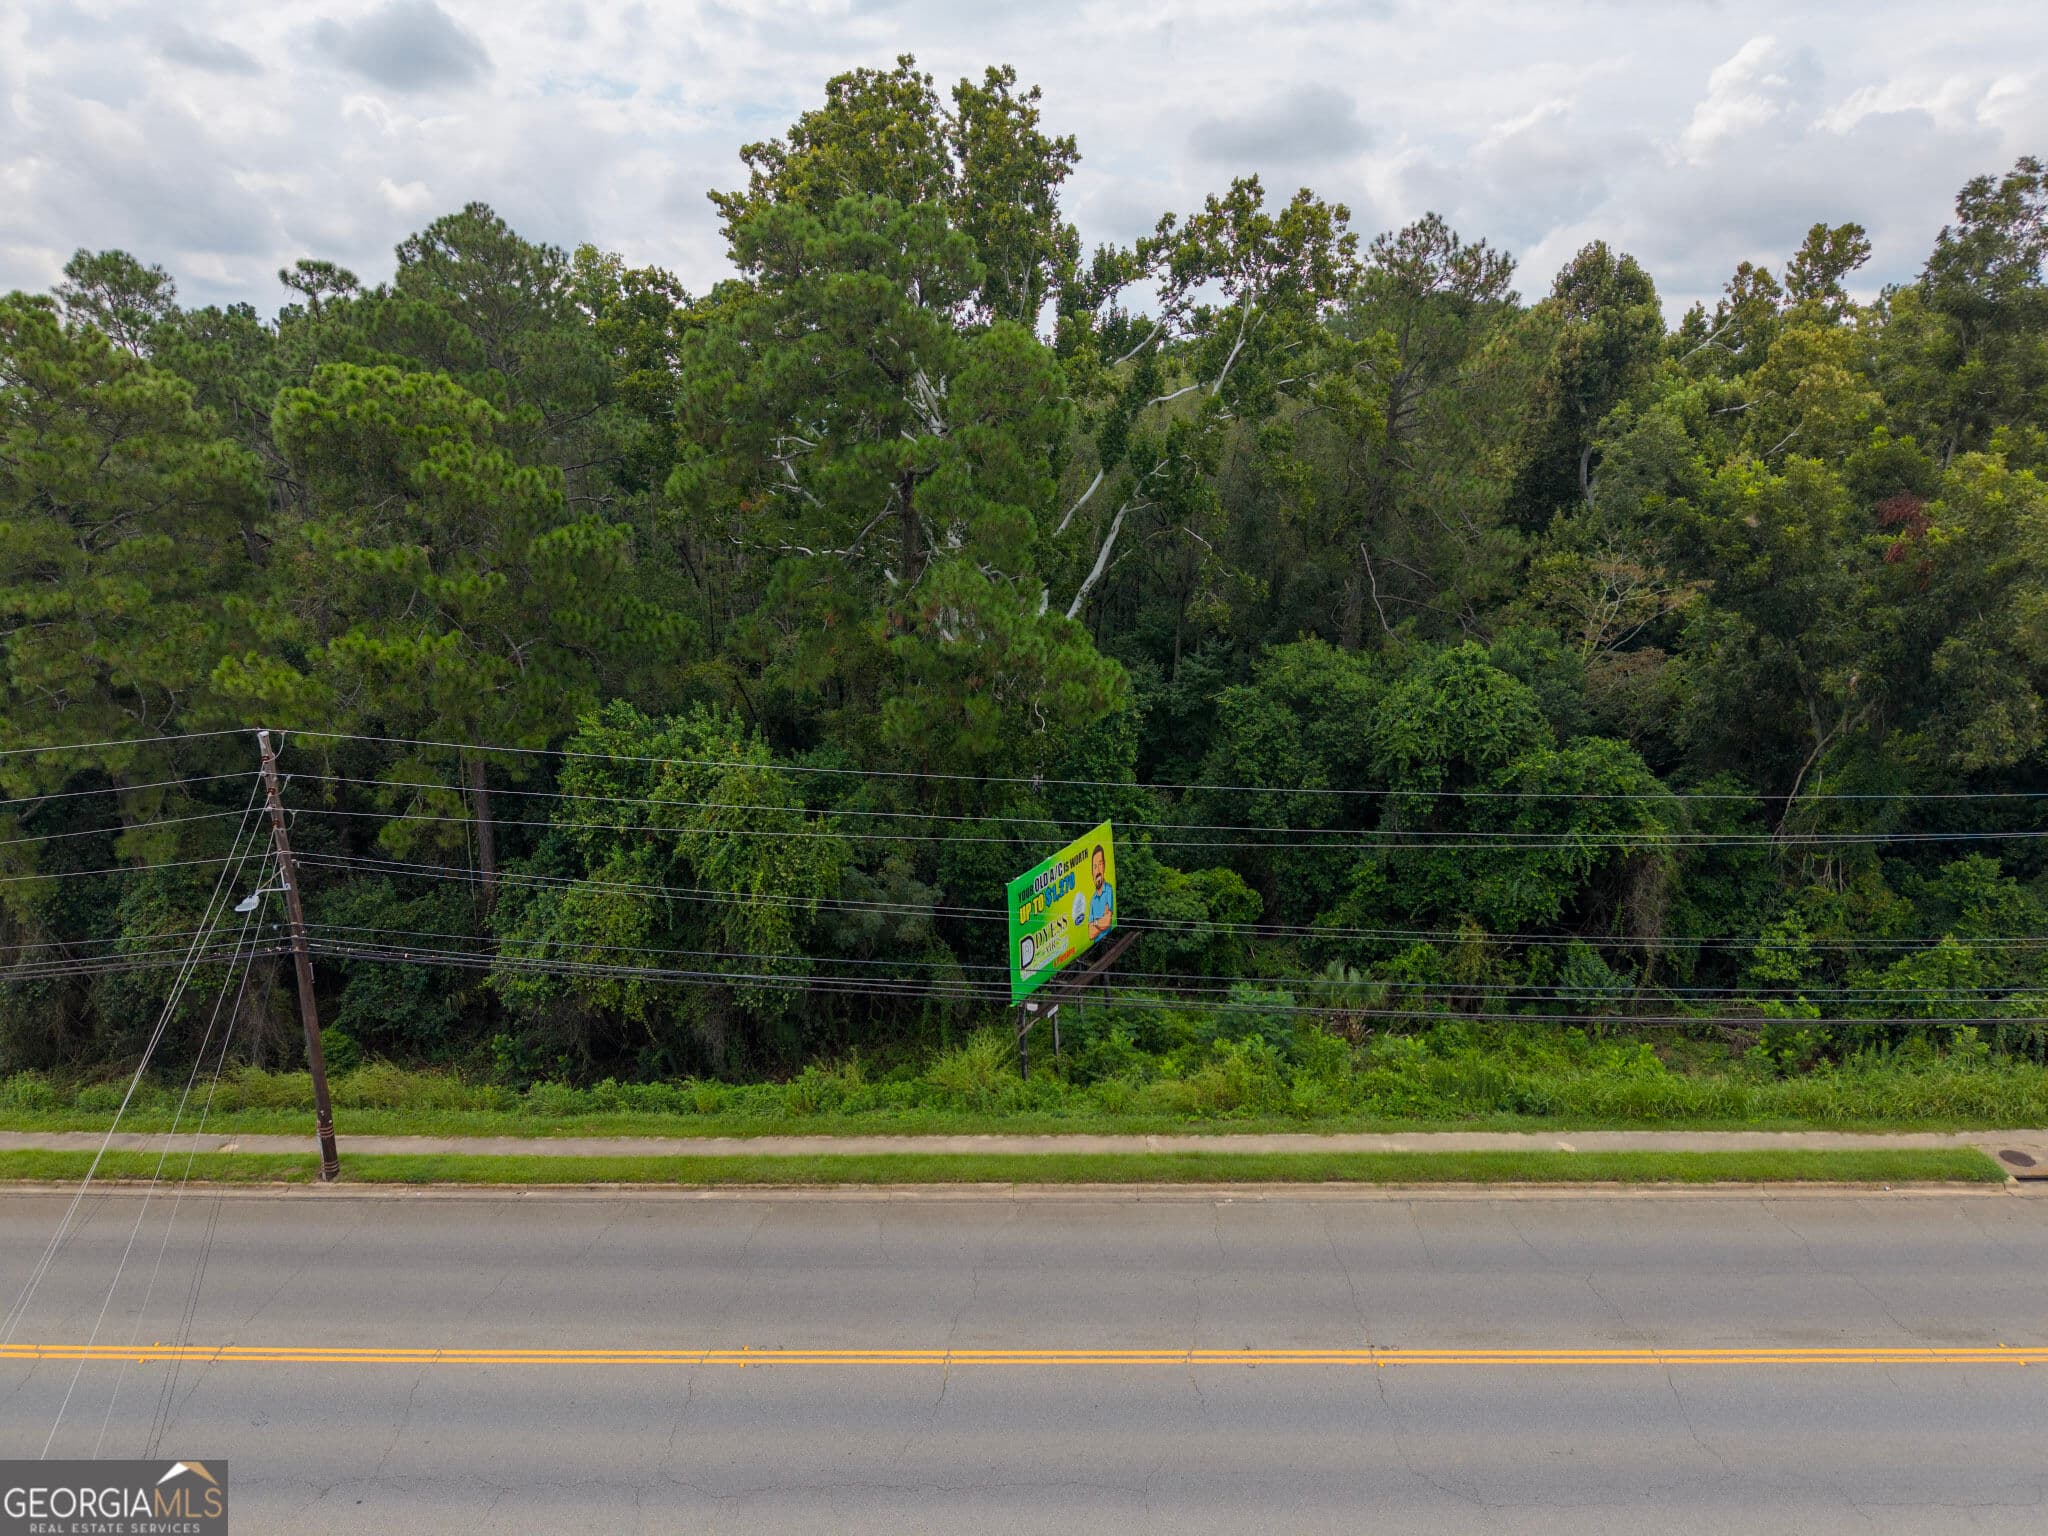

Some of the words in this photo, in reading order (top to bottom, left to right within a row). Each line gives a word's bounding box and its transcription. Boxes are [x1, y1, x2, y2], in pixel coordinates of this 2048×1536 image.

[1019, 885, 1035, 903] YOUR
[1035, 872, 1048, 893] OLD
[1049, 862, 1063, 883] A/C
[1063, 861, 1069, 874] IS
[1069, 848, 1089, 869] WORTH
[1019, 902, 1032, 925] UP
[1032, 893, 1045, 916] TO
[1035, 915, 1068, 949] DYESS
